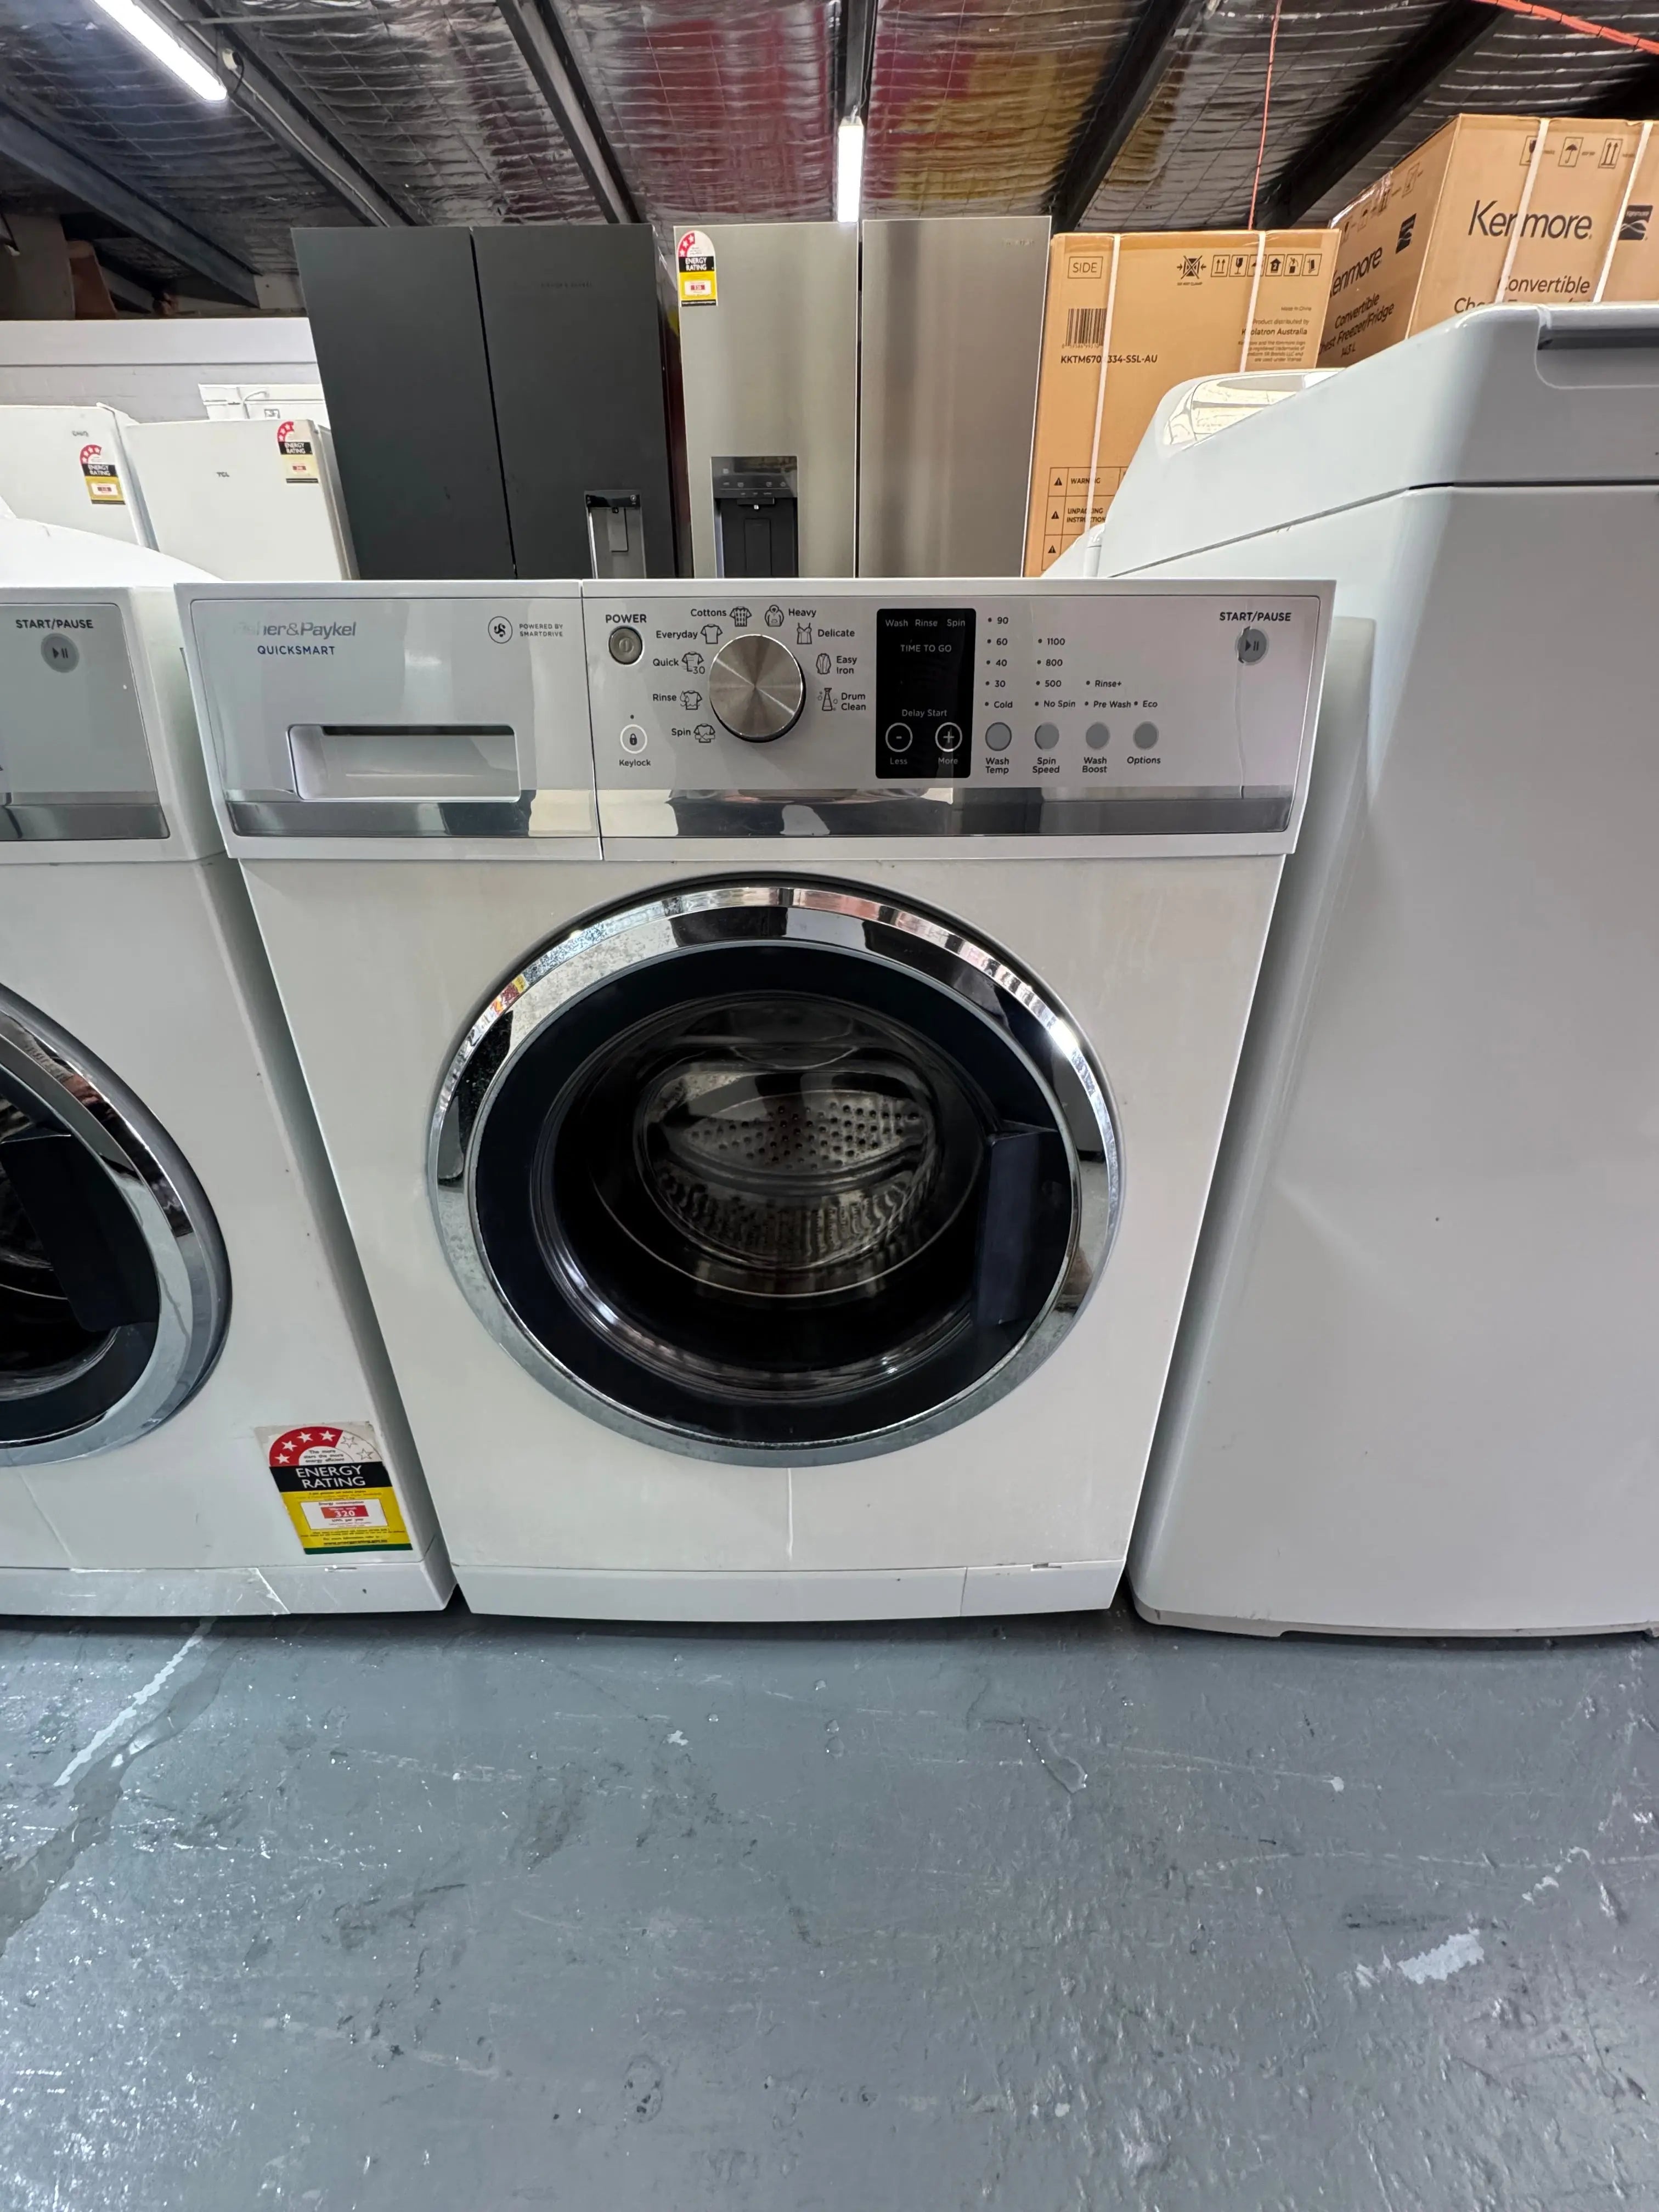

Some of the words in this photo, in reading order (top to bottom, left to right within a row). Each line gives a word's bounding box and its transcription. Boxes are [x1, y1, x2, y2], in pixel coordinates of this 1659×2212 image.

[1072, 262, 1097, 273] SIDE
[1335, 292, 1380, 329] Convertible
[1336, 303, 1394, 345] Freezer/Fridge
[1060, 354, 1158, 364] KKTM670334-SSL-AU
[690, 608, 727, 617] Cottons
[788, 608, 816, 618] Heavy
[1219, 611, 1292, 622] START/PAUSE
[605, 614, 647, 623] POWER
[915, 619, 938, 627] Rinse
[947, 618, 966, 628] Spin
[15, 618, 94, 630] START/PAUSE
[656, 630, 698, 640] Everyday
[817, 628, 855, 637] Delicate
[996, 637, 1008, 646] 60
[257, 645, 335, 655] QUICKSMART
[900, 644, 921, 652] TIME
[923, 644, 936, 652] TO
[938, 644, 952, 653] GO
[653, 658, 679, 667] Quick
[836, 655, 857, 665] Easy
[693, 666, 706, 675] 30
[1058, 699, 1076, 708] Spin
[901, 709, 925, 718] Delay
[671, 727, 691, 737] Spin
[619, 759, 651, 768] Keylock
[1037, 757, 1056, 765] Spin
[1084, 756, 1107, 764] Wash
[1126, 755, 1161, 765] Options
[985, 766, 1009, 775] Temp
[1032, 765, 1060, 775] Speed
[295, 1465, 362, 1477] ENERGY
[301, 1476, 366, 1488] RATING
